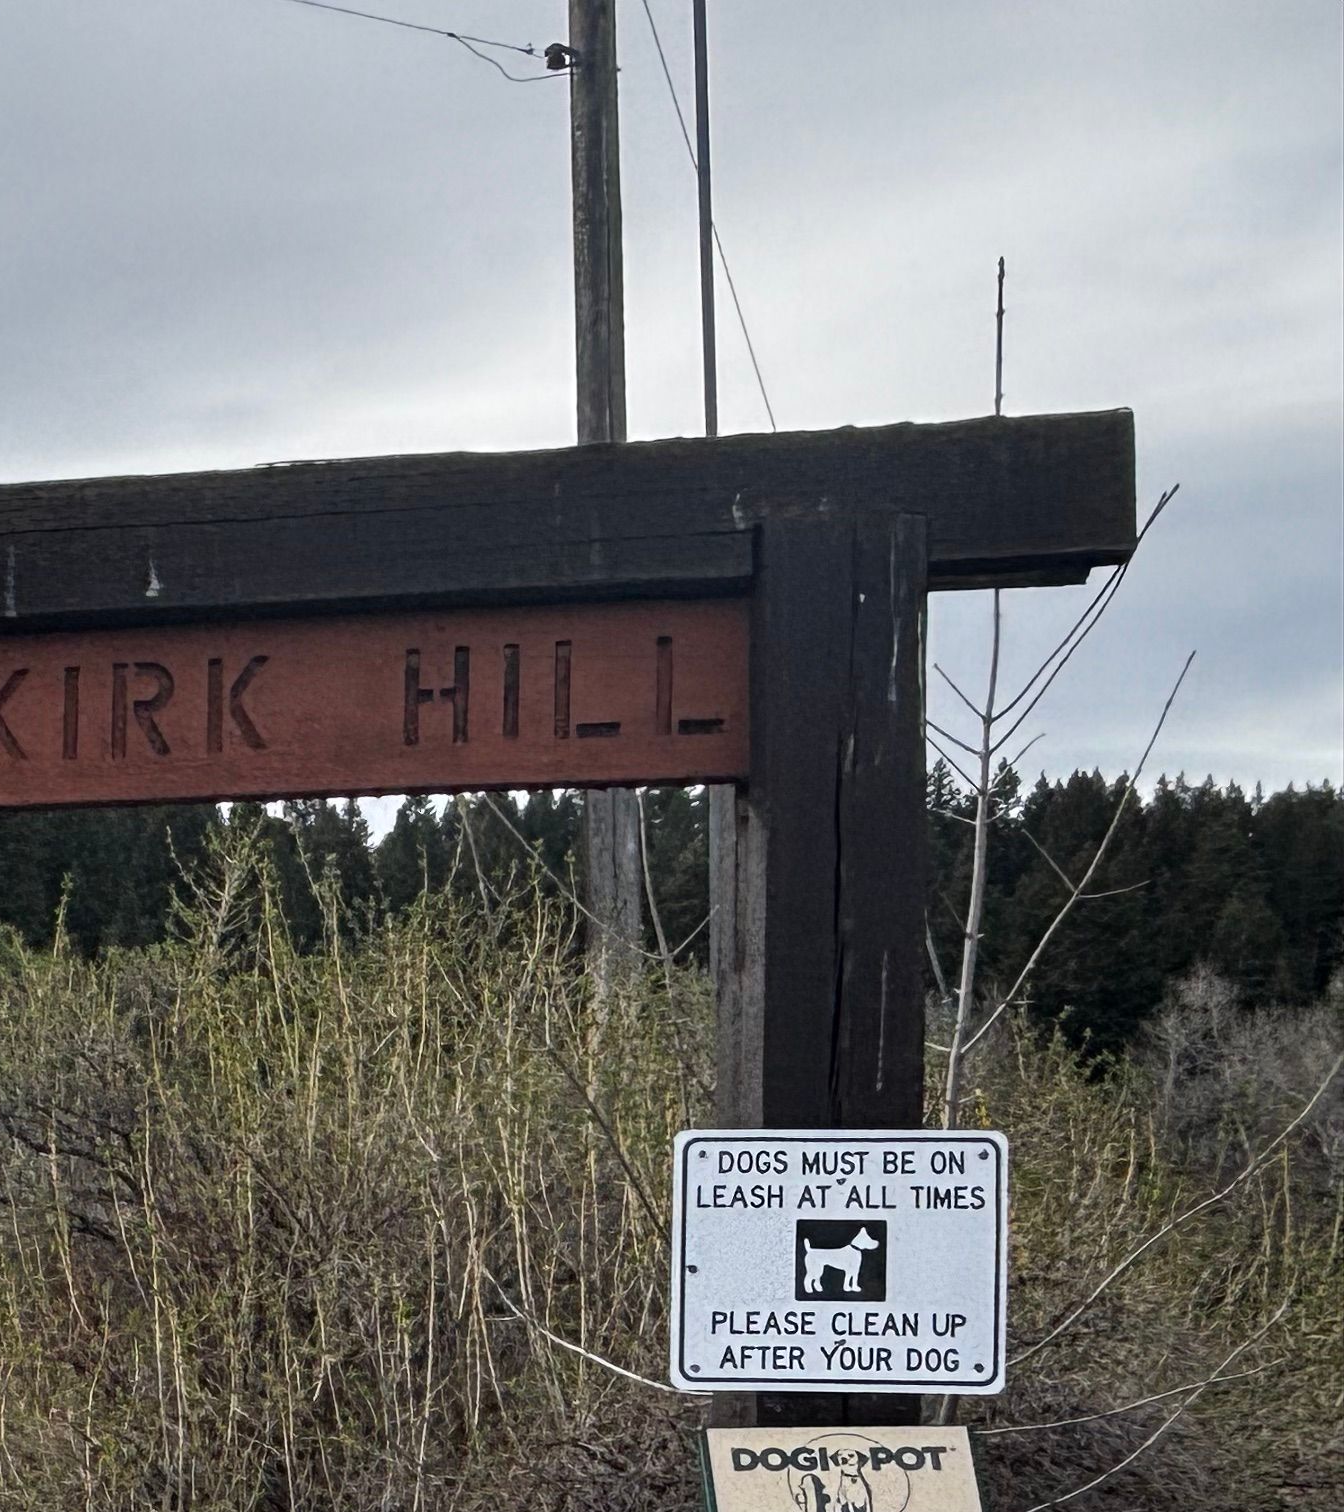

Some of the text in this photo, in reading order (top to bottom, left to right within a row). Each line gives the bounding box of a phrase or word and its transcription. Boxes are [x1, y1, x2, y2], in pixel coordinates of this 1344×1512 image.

[403, 634, 726, 747] HILL
[717, 1150, 966, 1176] DOGS MUST BE ON
[696, 1184, 987, 1211] LEASH AT ALL TIMES
[710, 1311, 967, 1338] PLEASE CLEAN UP
[719, 1345, 960, 1373] AFTER YOUR DOG
